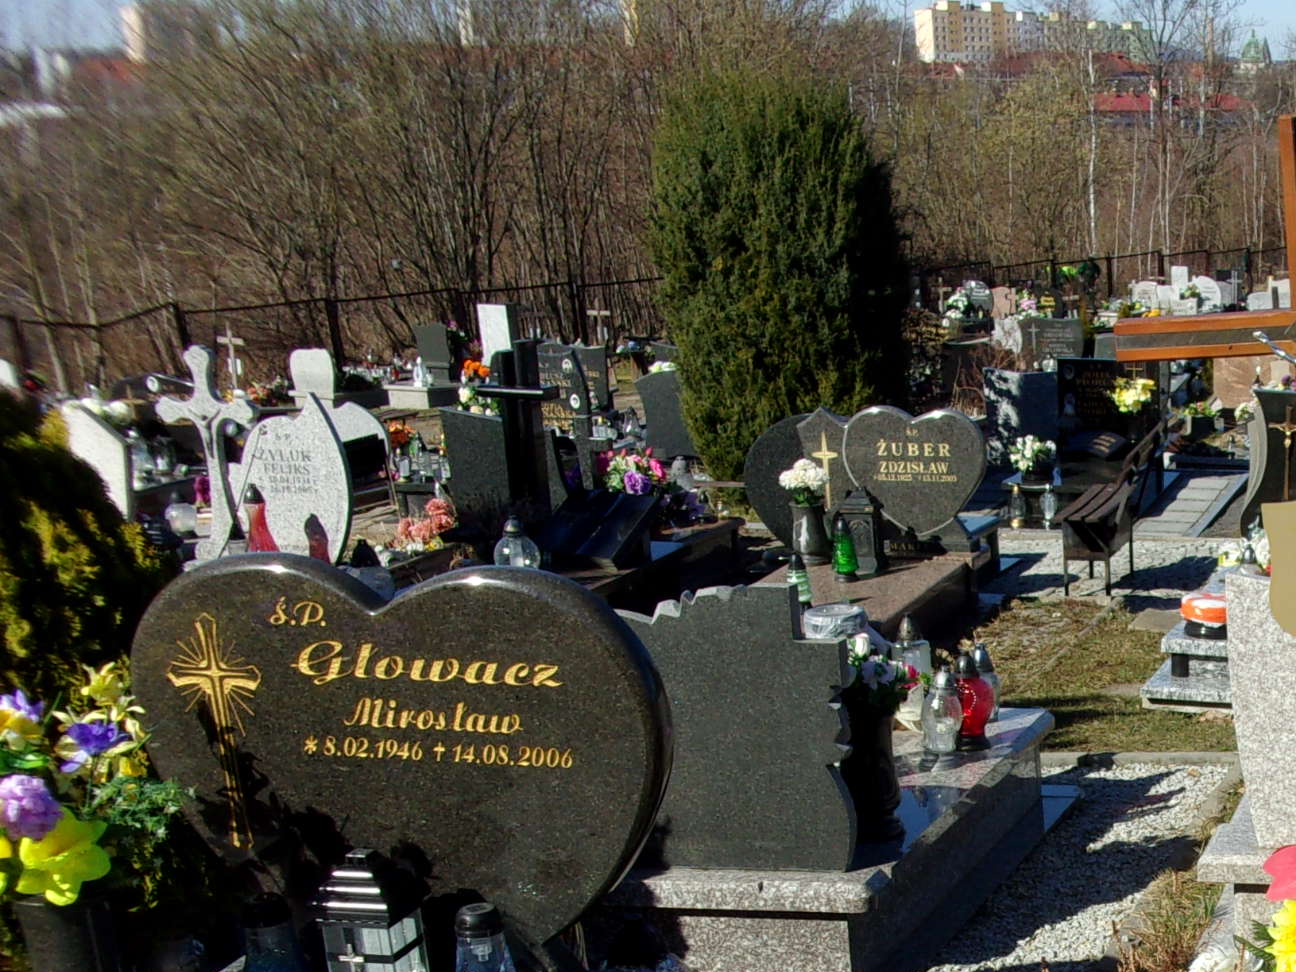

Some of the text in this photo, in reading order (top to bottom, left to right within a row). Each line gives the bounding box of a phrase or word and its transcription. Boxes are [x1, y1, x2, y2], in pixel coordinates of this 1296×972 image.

[876, 439, 951, 457] ŻUBER
[263, 463, 311, 475] FELIKS
[880, 461, 950, 474] ZDZISŁAW
[290, 640, 565, 688] Głowacz
[344, 697, 524, 734] Mirosław
[452, 743, 573, 769] 14.08.2006
